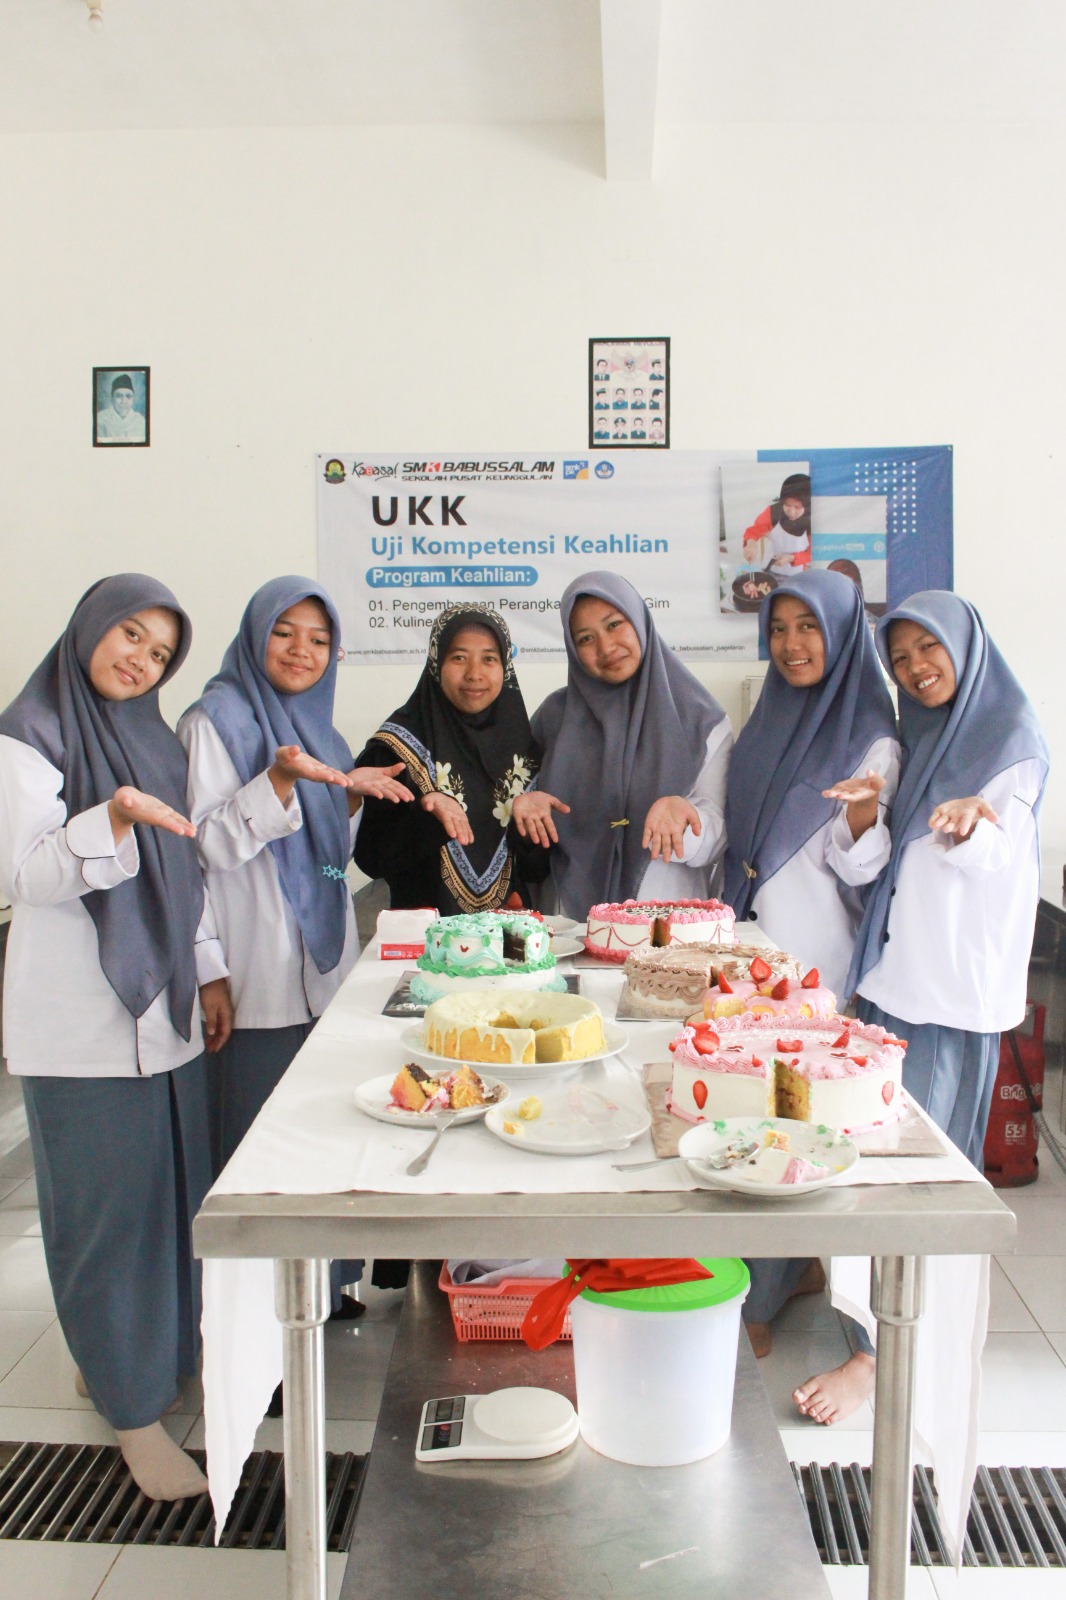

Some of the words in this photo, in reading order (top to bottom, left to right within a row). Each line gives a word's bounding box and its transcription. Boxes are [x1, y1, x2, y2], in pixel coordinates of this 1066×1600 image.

[402, 461, 441, 473] SMK
[442, 461, 555, 473] BABUSSALAM
[371, 495, 468, 527] UKK
[371, 537, 403, 561] Uji
[411, 535, 555, 560] Kompetensi
[564, 533, 669, 555] Keahlian
[372, 568, 446, 586] Program
[451, 567, 532, 583] Keahlian:
[368, 599, 389, 612] 01.
[369, 616, 389, 629] 02.
[393, 616, 436, 628] Kuline
